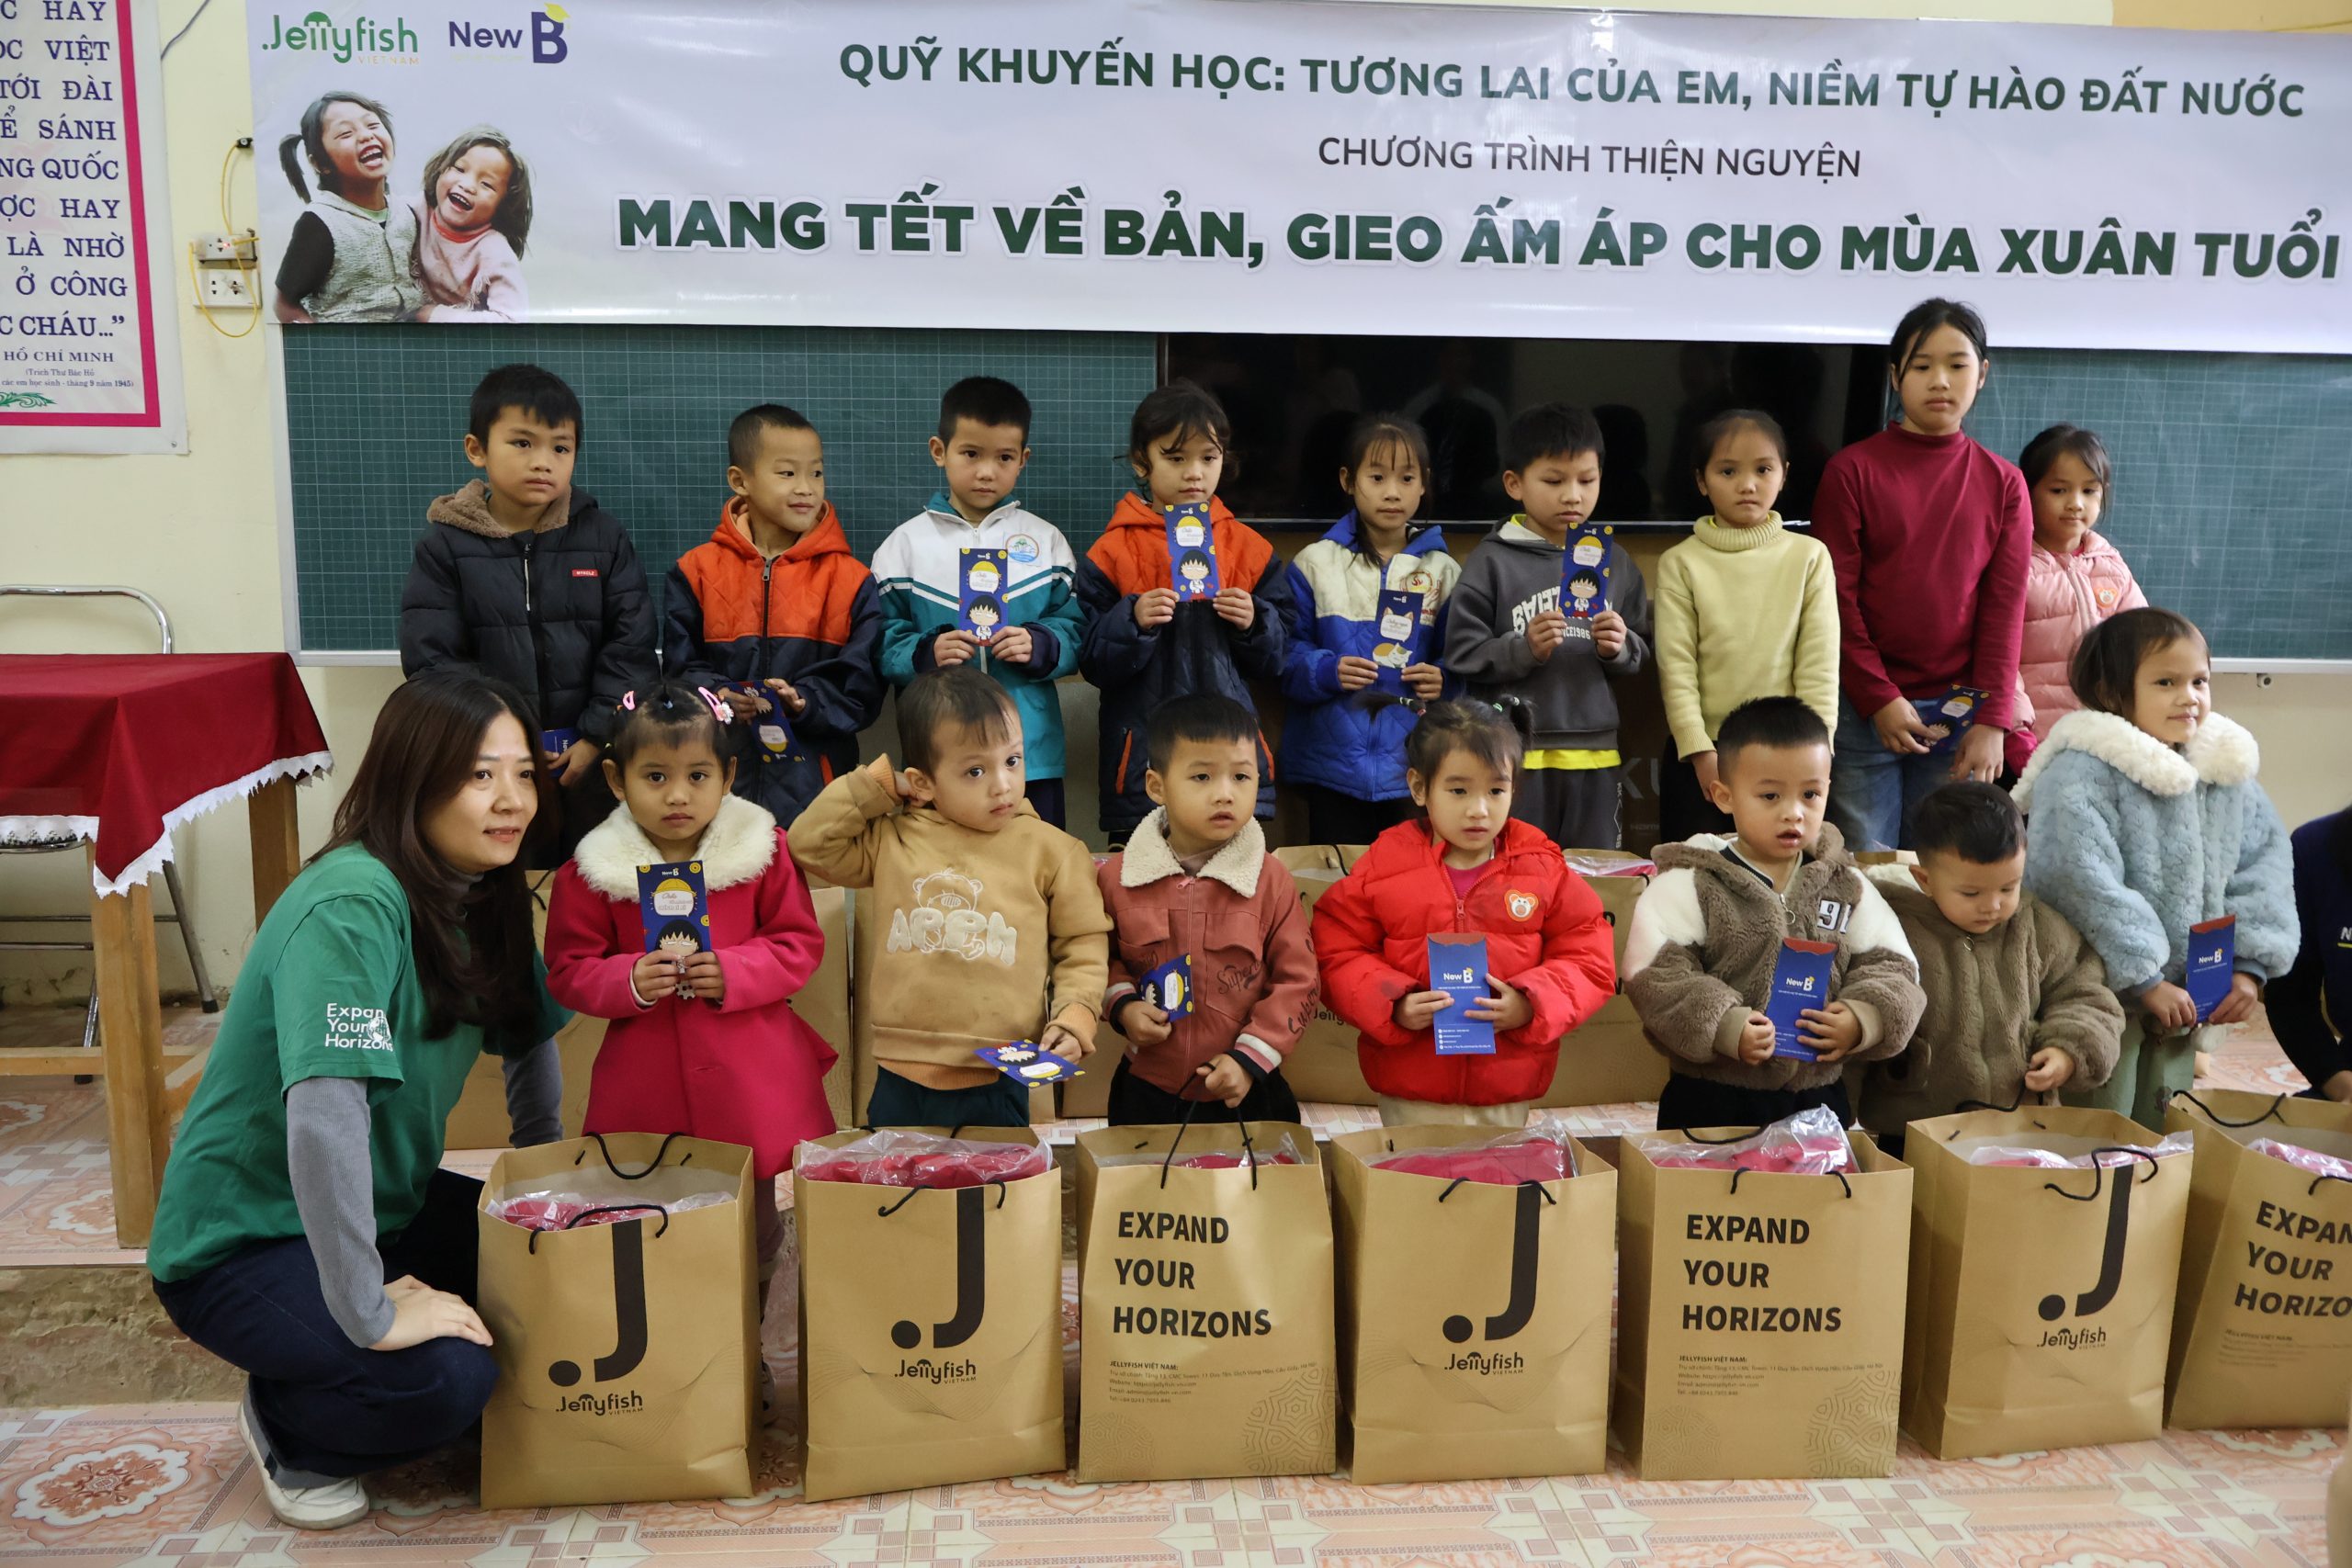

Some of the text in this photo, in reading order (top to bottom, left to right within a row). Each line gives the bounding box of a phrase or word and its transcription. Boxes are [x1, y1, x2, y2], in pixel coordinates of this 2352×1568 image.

[44, 1, 107, 20] HAY
[44, 34, 110, 66] VIỆT
[357, 55, 420, 65] VIETNAM
[62, 74, 113, 101] ĐÀI
[840, 35, 2304, 118] QUỸ KHUYẾN HỌC: TƯƠNG LAI CỦA EM, NIỀM TỰ HÀO ĐẤT NƯỚC
[39, 113, 117, 141] SÁNH
[41, 150, 119, 180] QUỐC
[1318, 135, 1860, 184] CHƯƠNG TRÌNH THIỆN NGUYỆN
[60, 198, 120, 219] HAY
[618, 183, 2339, 278] MANG TẾT VỀ BẢN, GIEO ẤM ÁP CHO MÙA XUÂN TUỔI
[7, 231, 125, 258] LÀ NHỜ
[16, 265, 128, 297] Ở CÔNG
[69, 352, 115, 363] MINH
[1442, 973, 1462, 981] New
[1786, 976, 1804, 987] New
[327, 1017, 369, 1033] Your
[324, 1033, 394, 1053] Horizons
[1118, 1212, 1229, 1244] EXPAND
[1686, 1214, 1810, 1245] EXPAND
[1683, 1259, 1770, 1288] YOUR
[2247, 1240, 2334, 1280] YOUR
[1114, 1258, 1195, 1290] YOUR
[1113, 1306, 1272, 1338] HORIZONS
[1682, 1304, 1842, 1332] HORIZONS
[1110, 1360, 1143, 1369] JELLYFISH
[1679, 1354, 1713, 1362] JELLYFISH
[1730, 1355, 1747, 1363] NAM:
[944, 1376, 977, 1385] VIETNAM
[608, 1407, 643, 1416] VIETNAM
